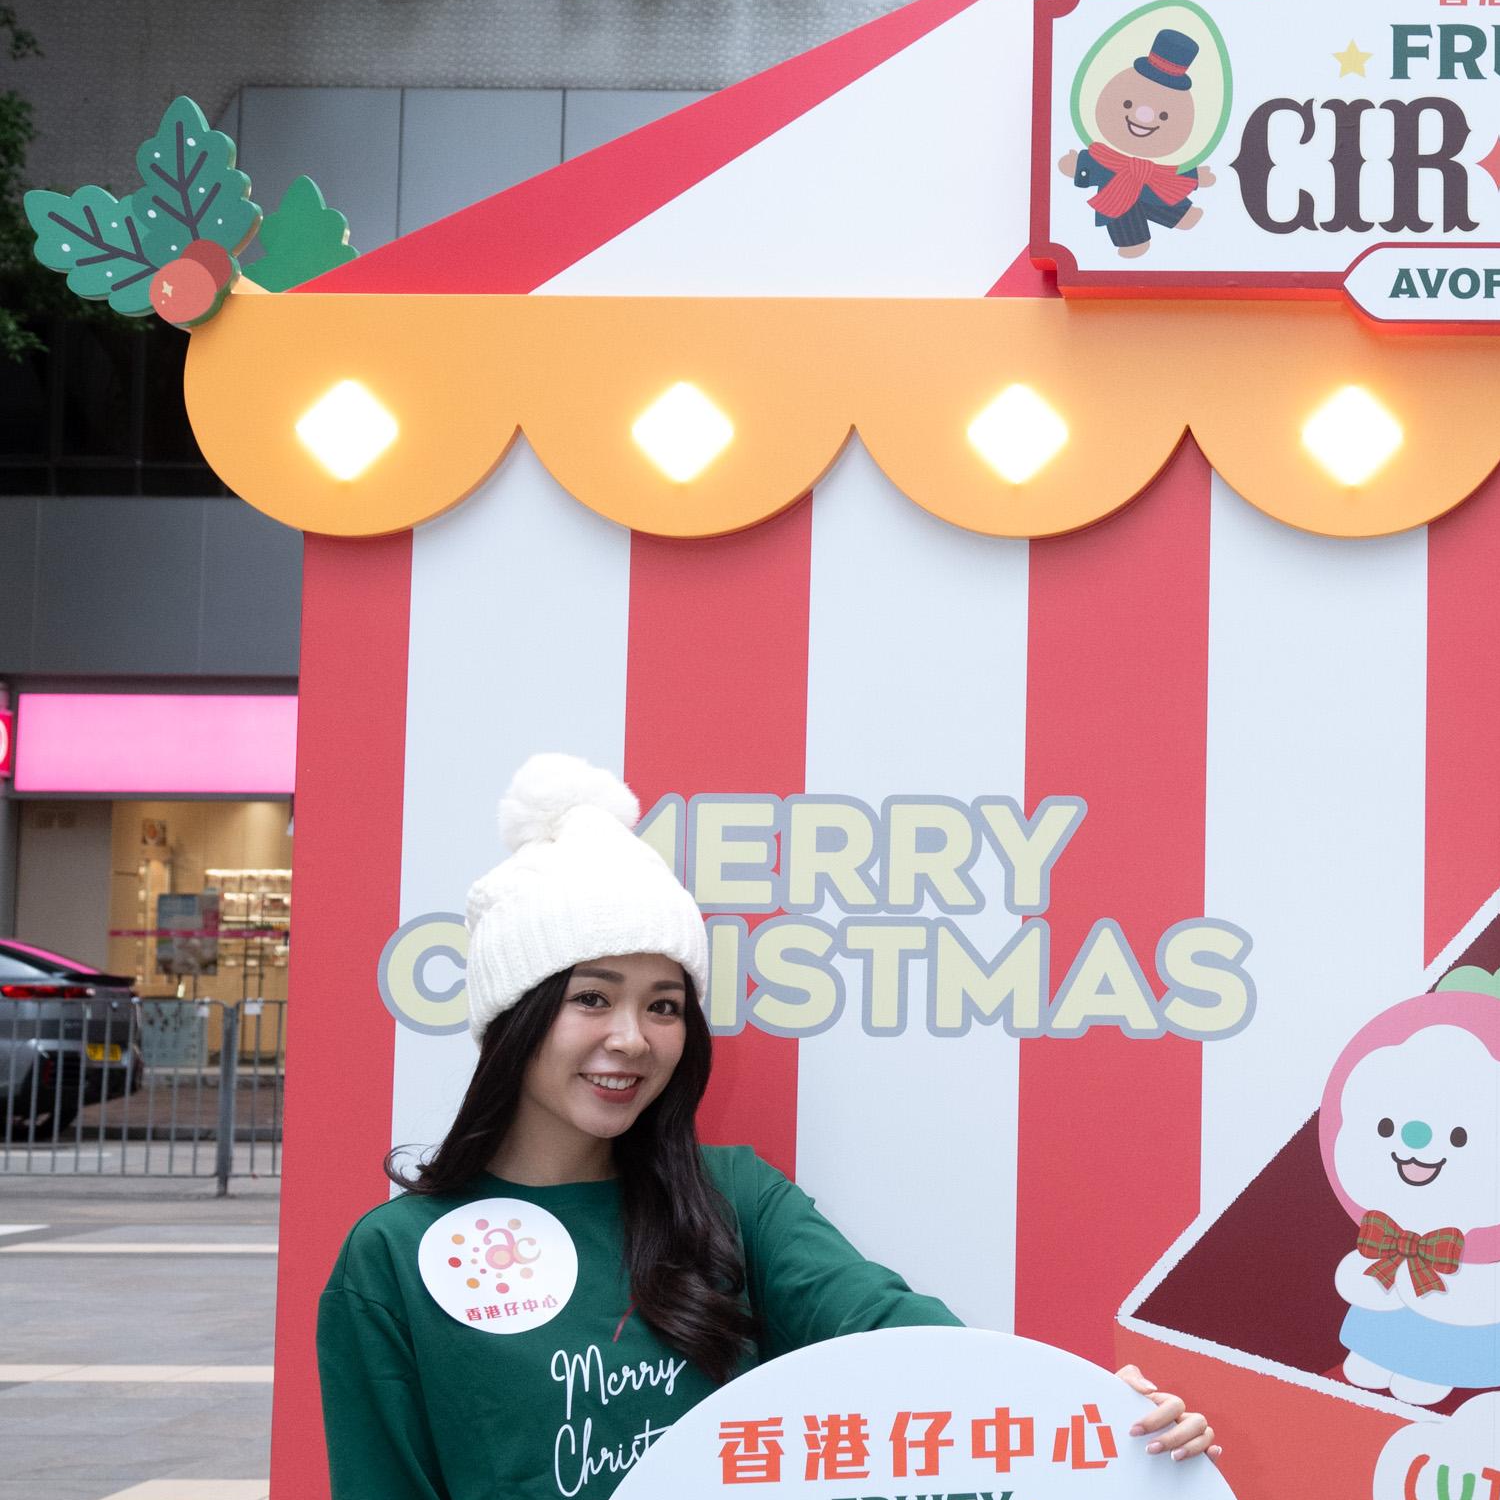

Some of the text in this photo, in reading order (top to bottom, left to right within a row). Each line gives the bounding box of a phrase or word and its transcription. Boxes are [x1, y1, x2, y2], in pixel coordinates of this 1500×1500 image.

[378, 912, 1258, 1041] CISTMAS
[465, 1295, 559, 1322] 香港仔中心
[551, 1345, 687, 1420] Merry
[555, 1417, 673, 1497] Christ
[718, 1403, 1118, 1486] 香港仔中心
